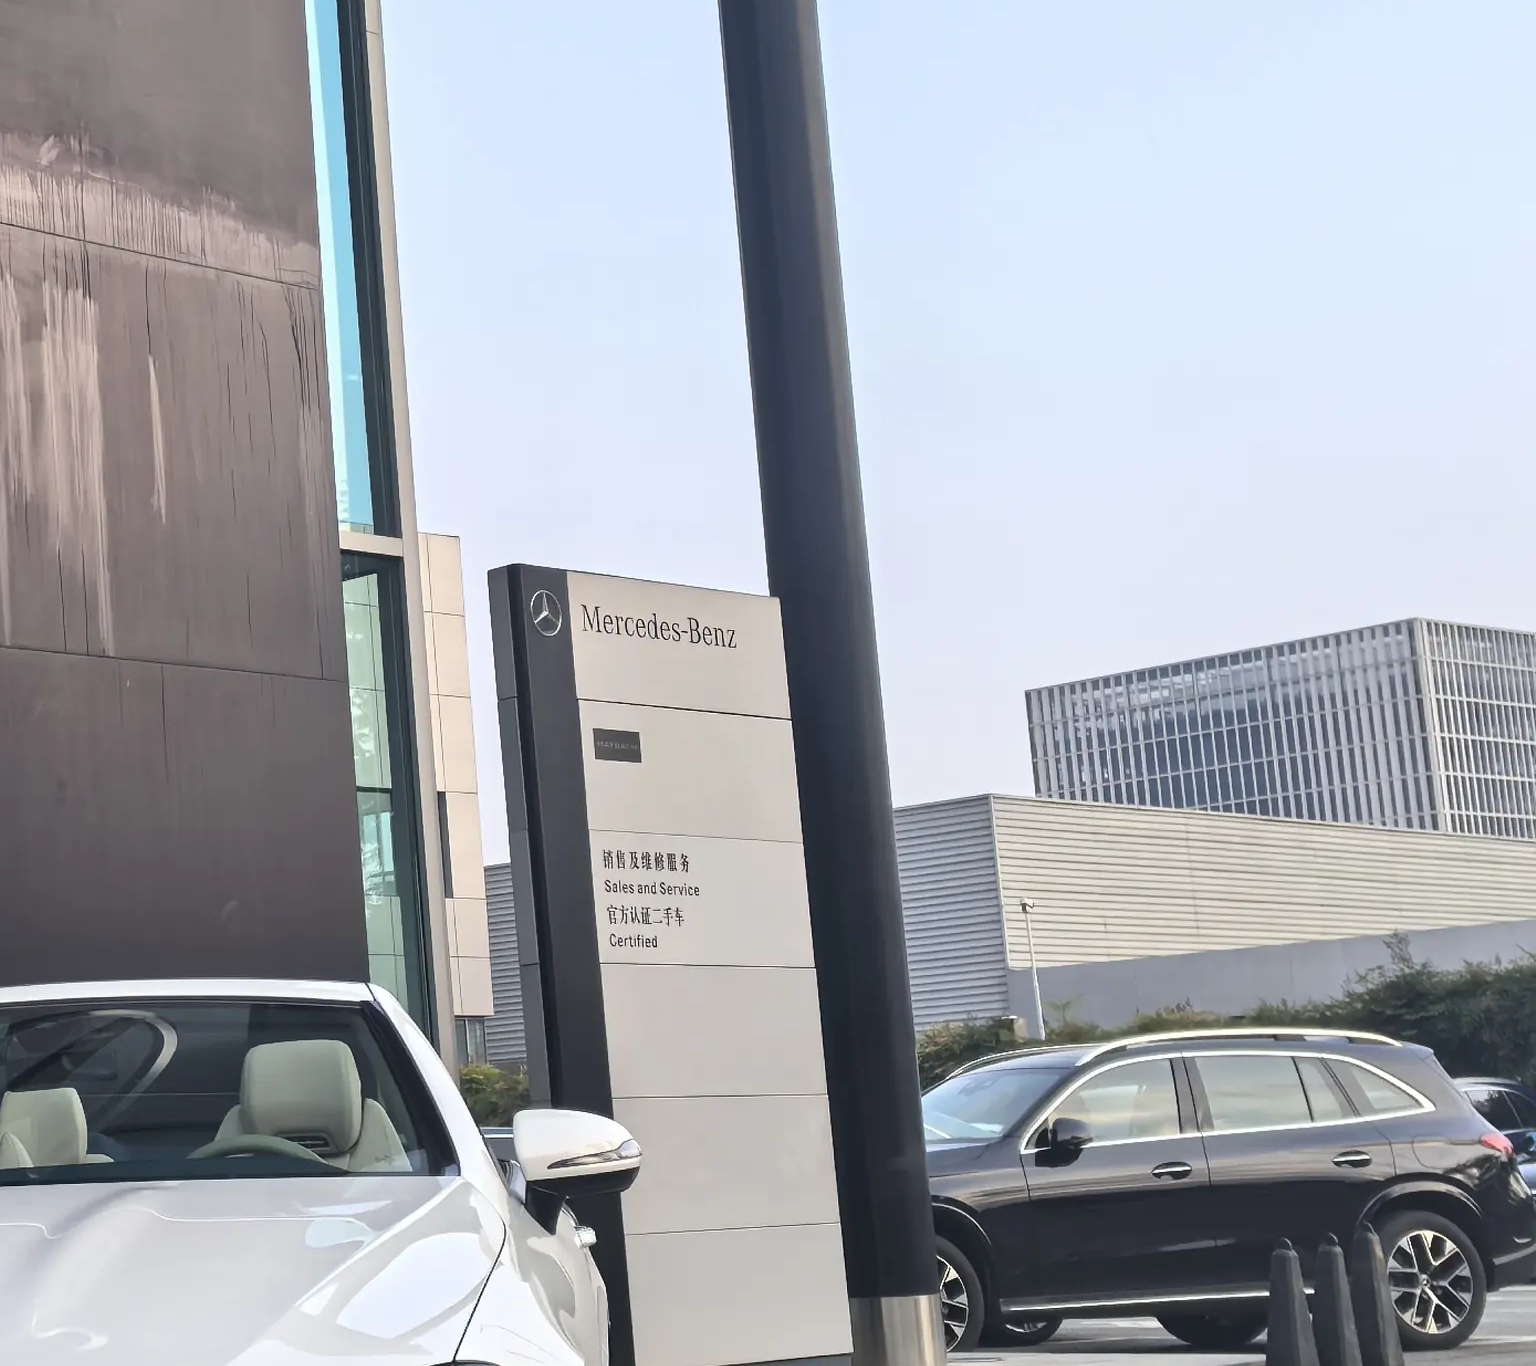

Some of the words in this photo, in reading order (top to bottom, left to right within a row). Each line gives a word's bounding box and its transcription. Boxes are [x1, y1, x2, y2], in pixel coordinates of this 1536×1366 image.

[580, 603, 737, 649] Mercedes-Benz
[602, 849, 690, 873] 销售及维修服务
[604, 879, 635, 894] Sales
[637, 881, 657, 895] and
[659, 881, 700, 896] Service
[606, 904, 685, 927] 官方认证二手车
[609, 933, 658, 948] Certified
